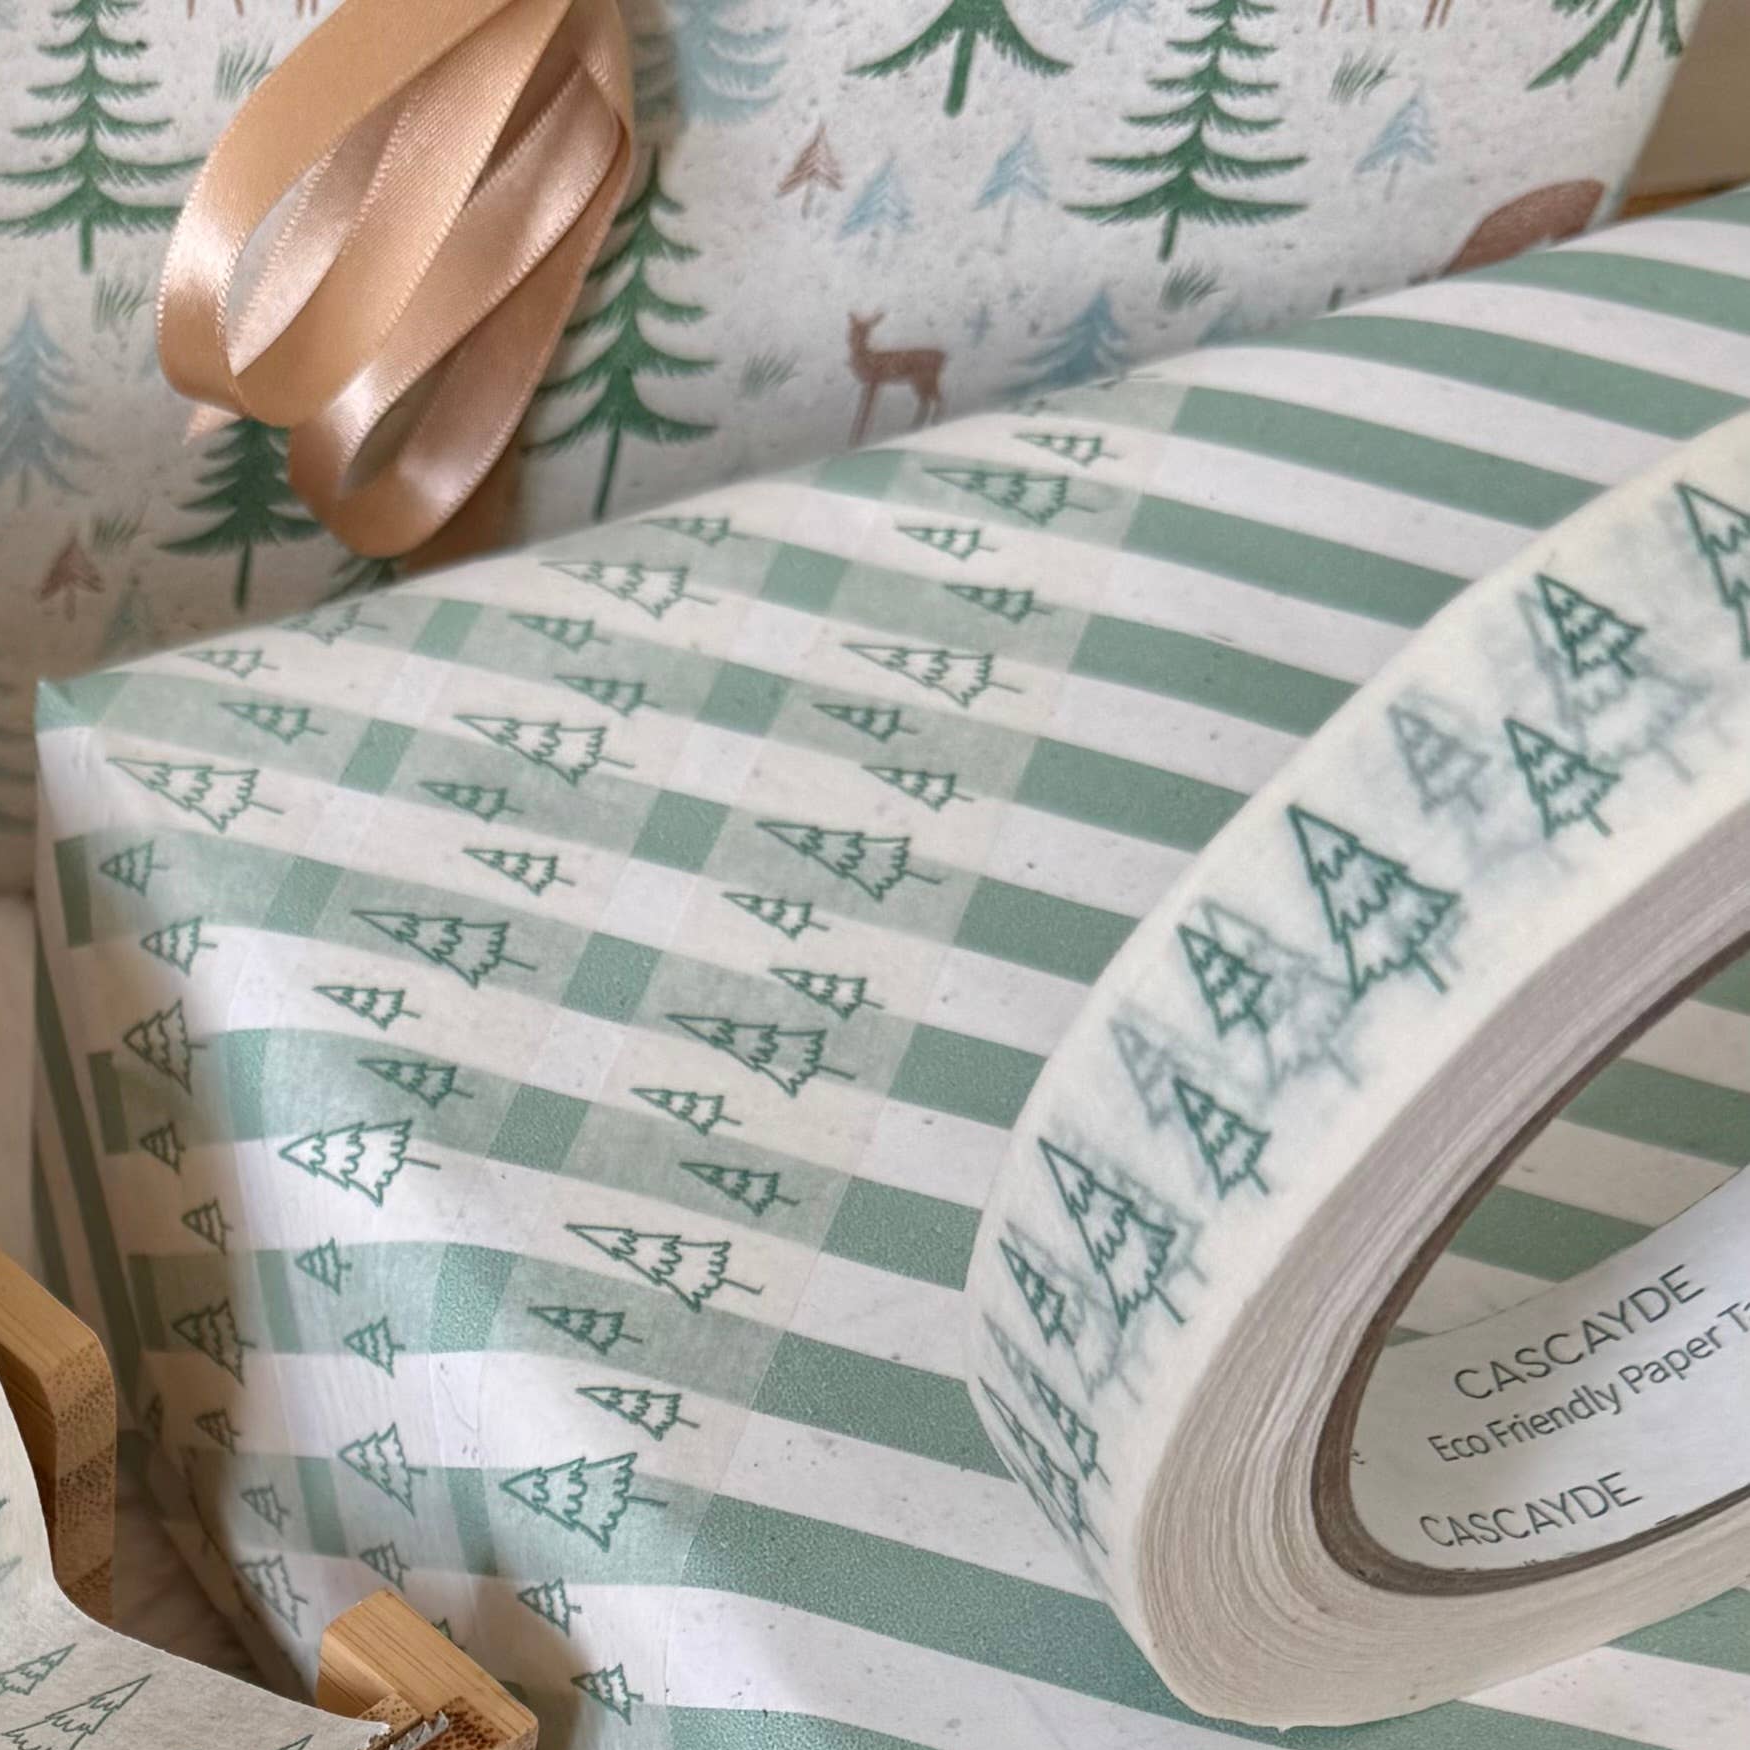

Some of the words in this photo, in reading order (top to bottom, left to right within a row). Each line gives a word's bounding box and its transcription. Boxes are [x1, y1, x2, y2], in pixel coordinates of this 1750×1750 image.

[1427, 1432, 1490, 1462] Eco
[1486, 1382, 1623, 1448] Friendly
[1617, 1326, 1722, 1394] Paper
[1455, 1264, 1705, 1399] CASCAYDE
[1420, 1471, 1643, 1547] CASCAYDE
